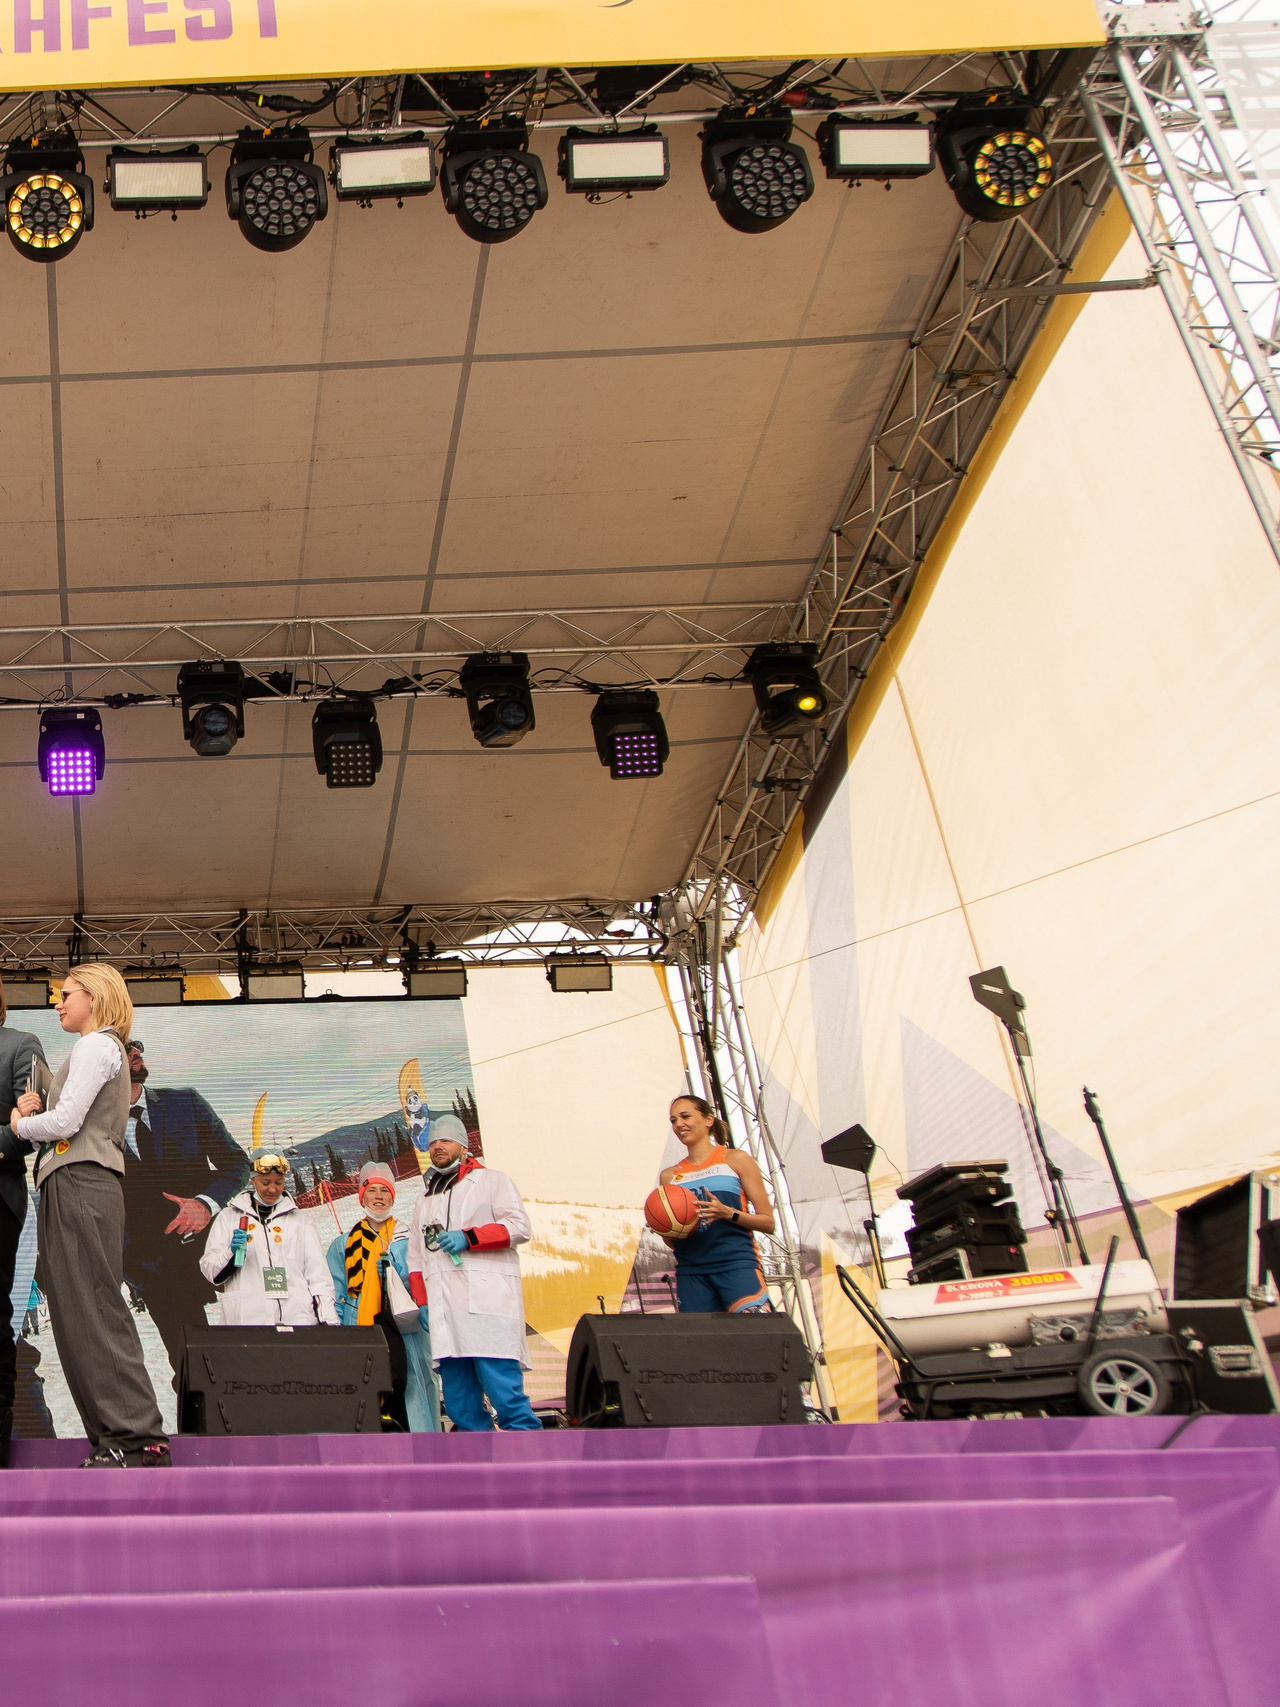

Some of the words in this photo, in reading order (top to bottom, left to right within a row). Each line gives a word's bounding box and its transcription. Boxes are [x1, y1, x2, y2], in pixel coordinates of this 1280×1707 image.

[945, 1280, 1003, 1293] KERONA
[1010, 1272, 1066, 1287] 30000
[639, 1369, 779, 1384] ProTone
[223, 1381, 359, 1395] ProTone
